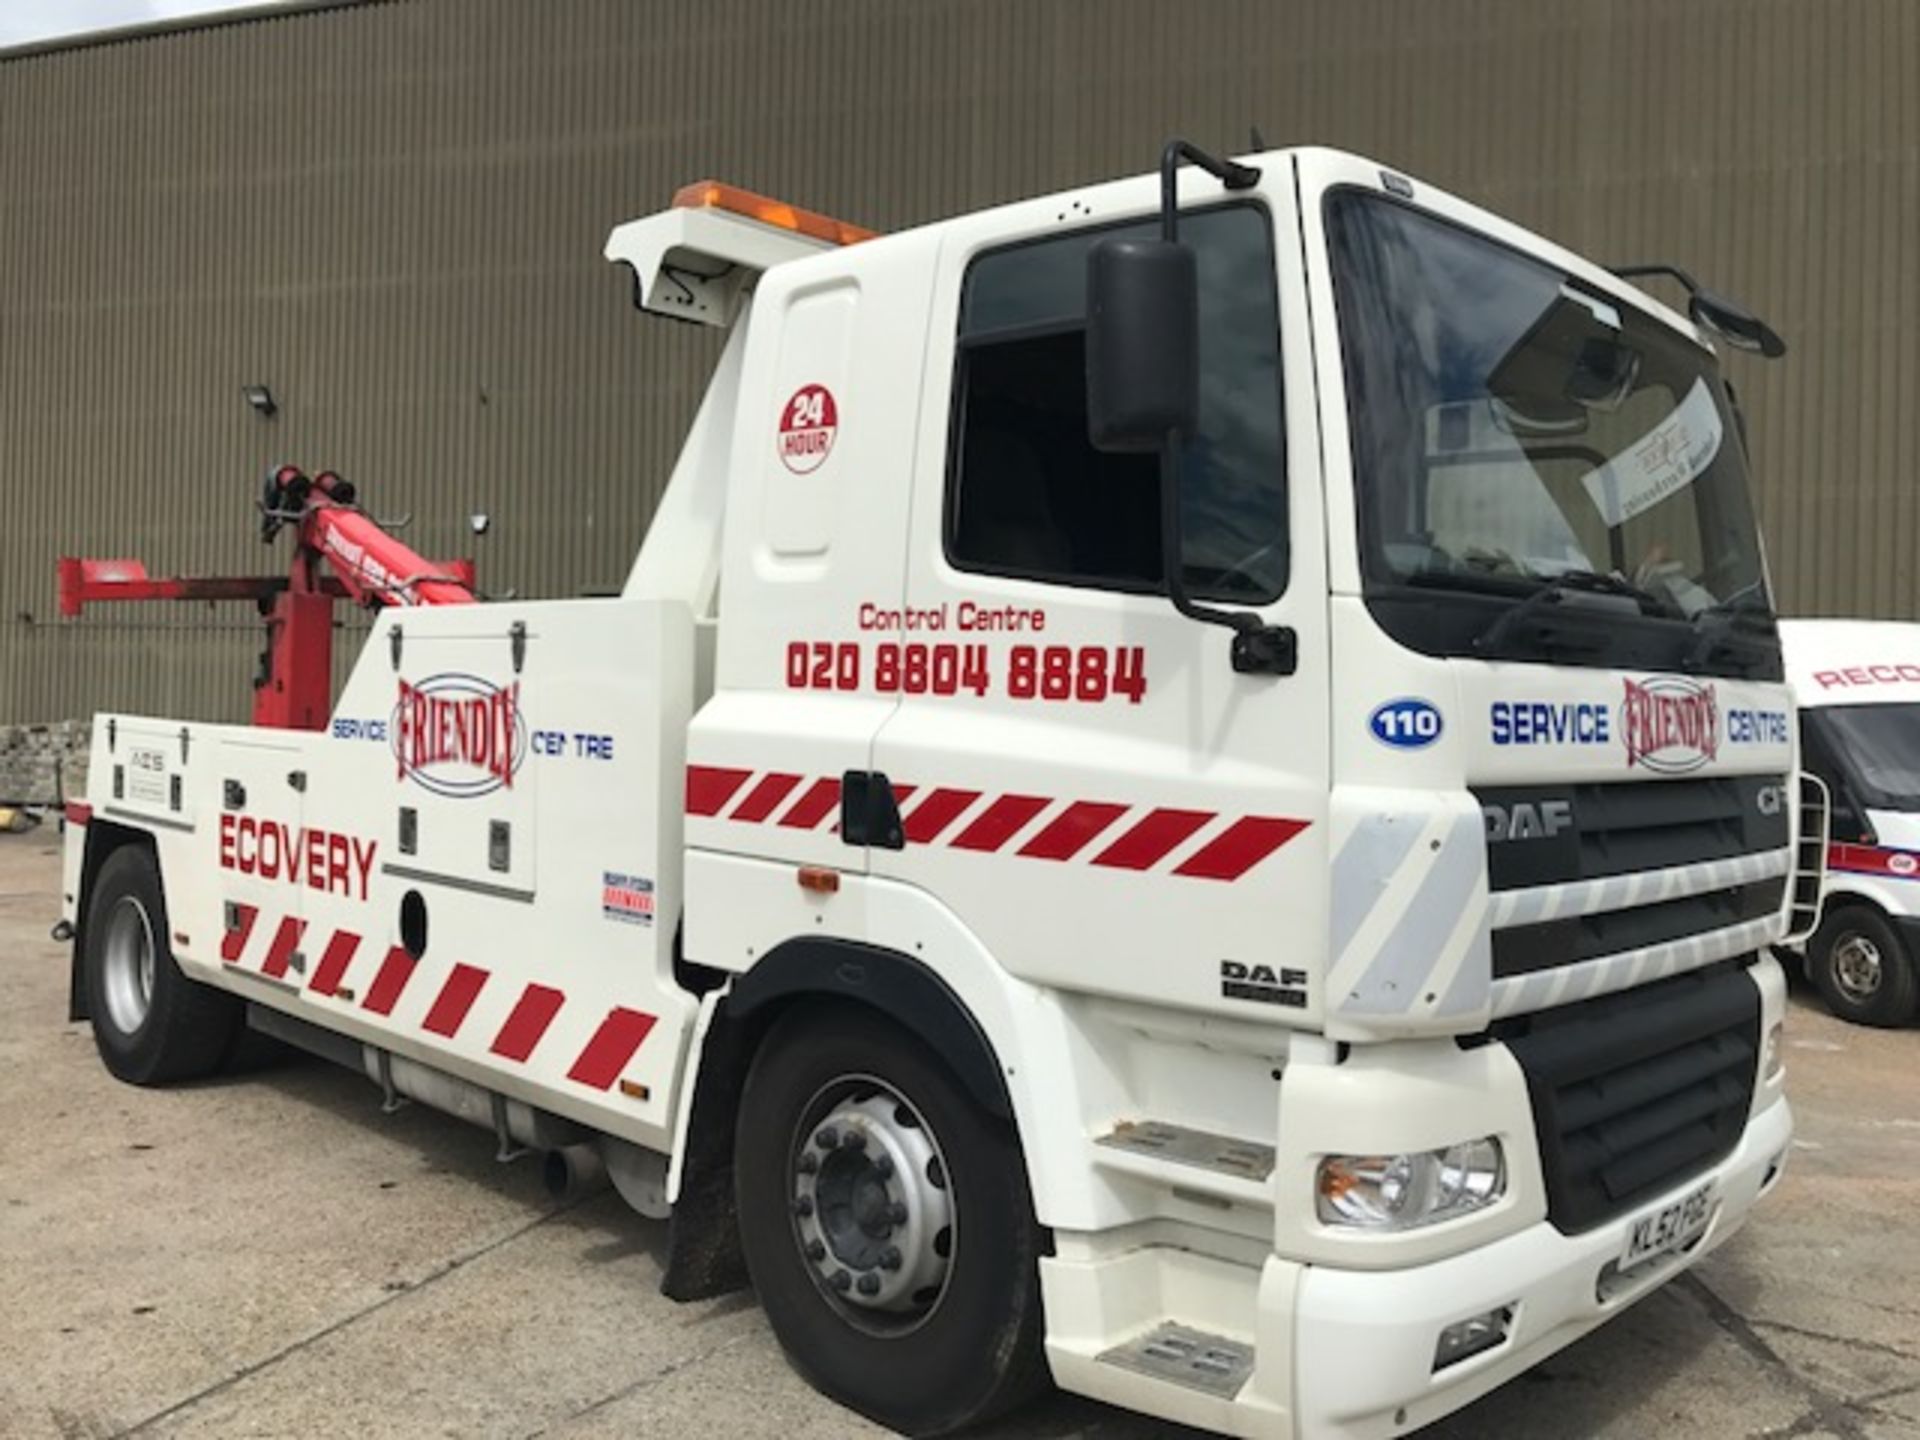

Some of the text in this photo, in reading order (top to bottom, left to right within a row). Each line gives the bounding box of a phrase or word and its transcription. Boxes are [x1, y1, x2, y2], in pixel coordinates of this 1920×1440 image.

[791, 392, 824, 428] 24
[784, 430, 829, 456] HOUR
[859, 601, 1046, 632] Control Centre
[786, 641, 1147, 704] 020 8804 8884
[332, 717, 387, 742] SERVICE
[396, 678, 521, 789] FRIENDLY
[1377, 709, 1438, 736] 110
[1490, 676, 1789, 769] SERVICE FRIENDLY CENTRE
[1482, 800, 1573, 841] DAF
[219, 812, 377, 902] ECOVERY
[1220, 959, 1308, 986] DAF
